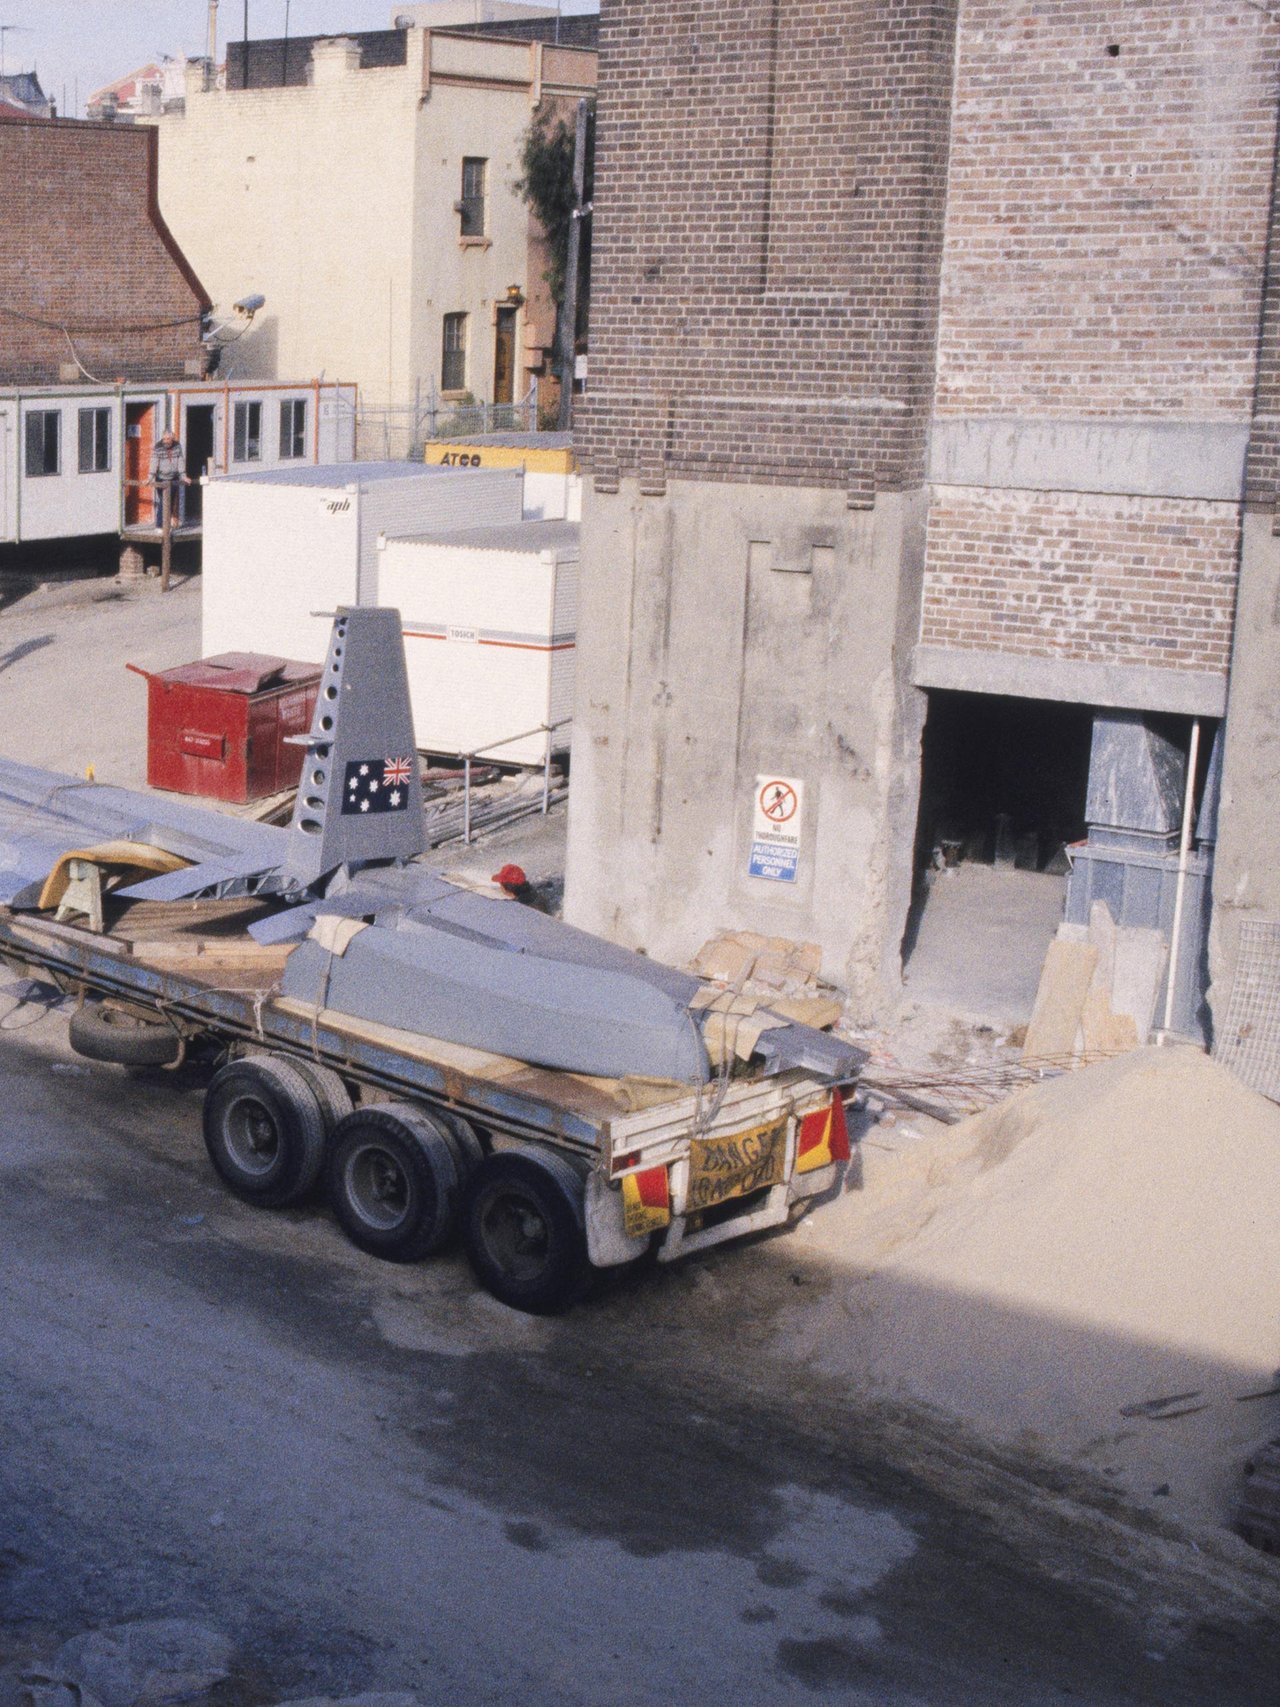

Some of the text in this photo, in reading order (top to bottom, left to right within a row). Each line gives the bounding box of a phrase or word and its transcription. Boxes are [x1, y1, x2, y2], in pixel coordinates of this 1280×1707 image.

[440, 452, 481, 467] ATCO
[773, 824, 782, 832] NO
[756, 832, 798, 844] THOROUGHFARE
[752, 854, 795, 868] PERSONNEL
[762, 866, 782, 877] ONLY
